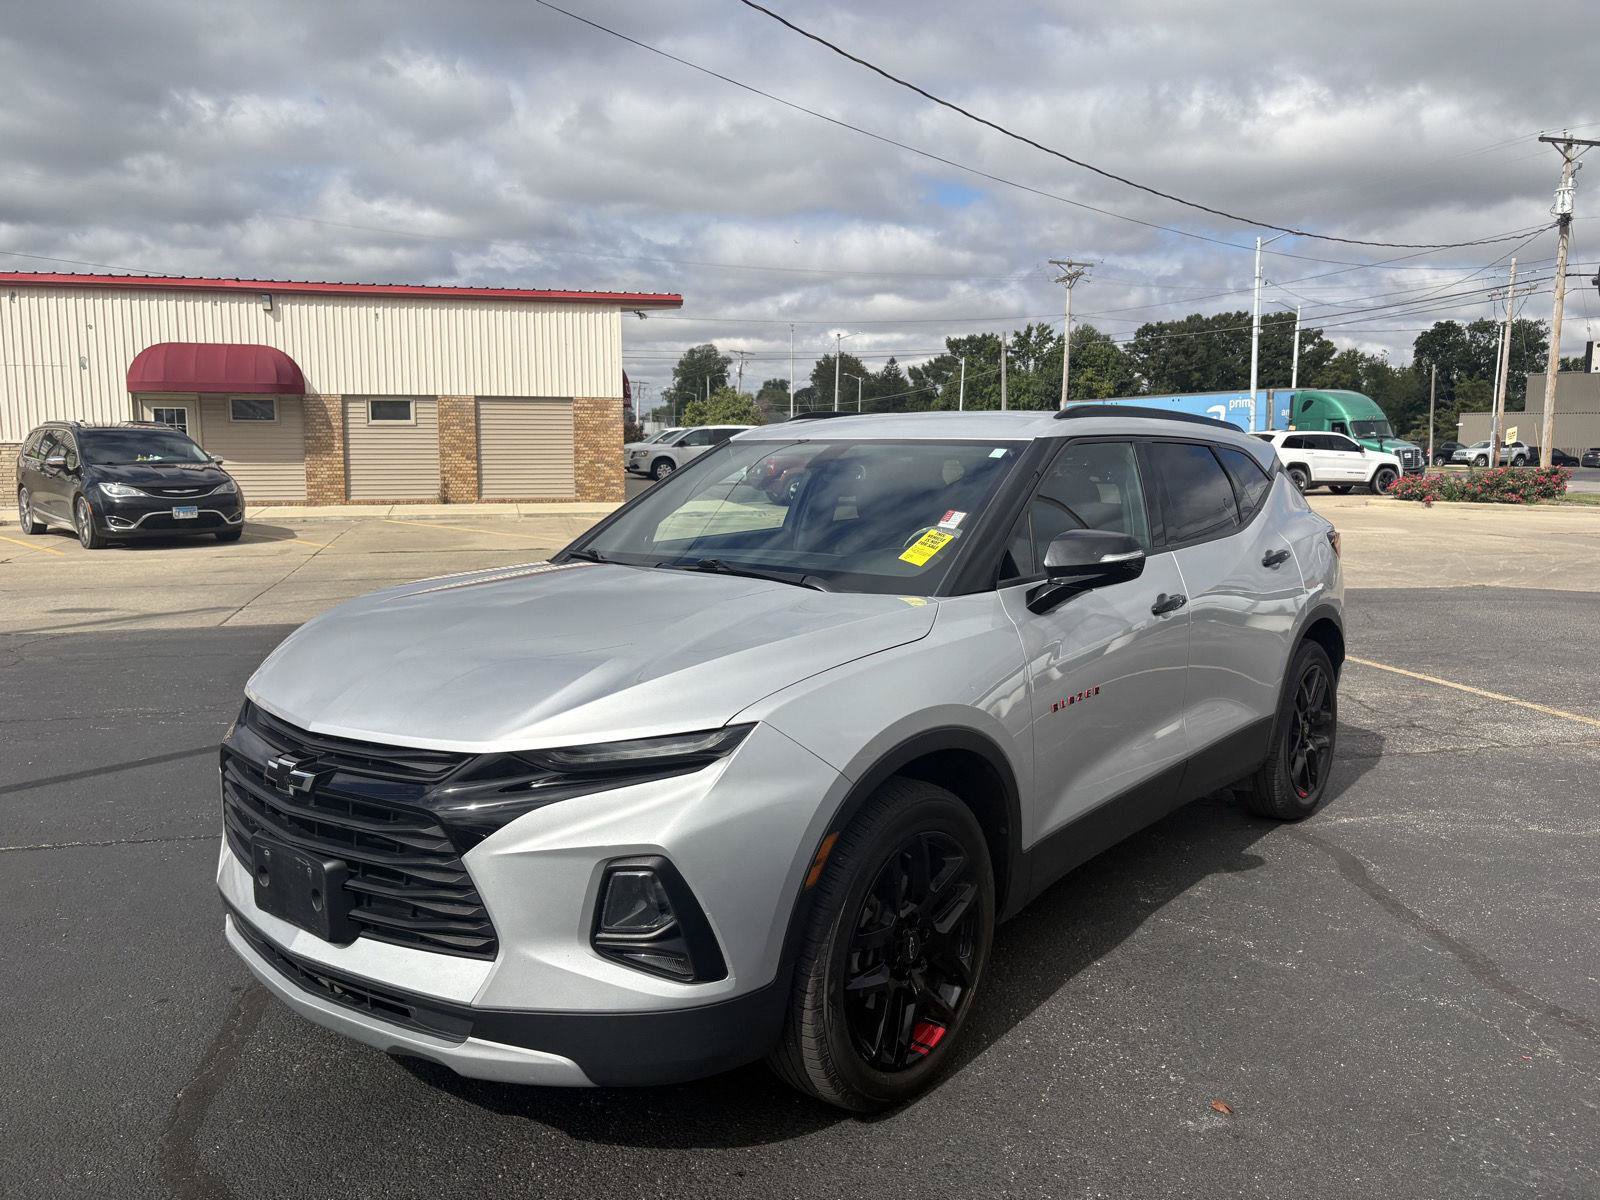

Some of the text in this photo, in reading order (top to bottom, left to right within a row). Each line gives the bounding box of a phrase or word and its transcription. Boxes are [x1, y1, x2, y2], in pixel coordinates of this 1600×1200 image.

[1229, 396, 1252, 411] prim
[927, 534, 947, 543] VEHICLE
[1051, 686, 1100, 713] BLAZER
